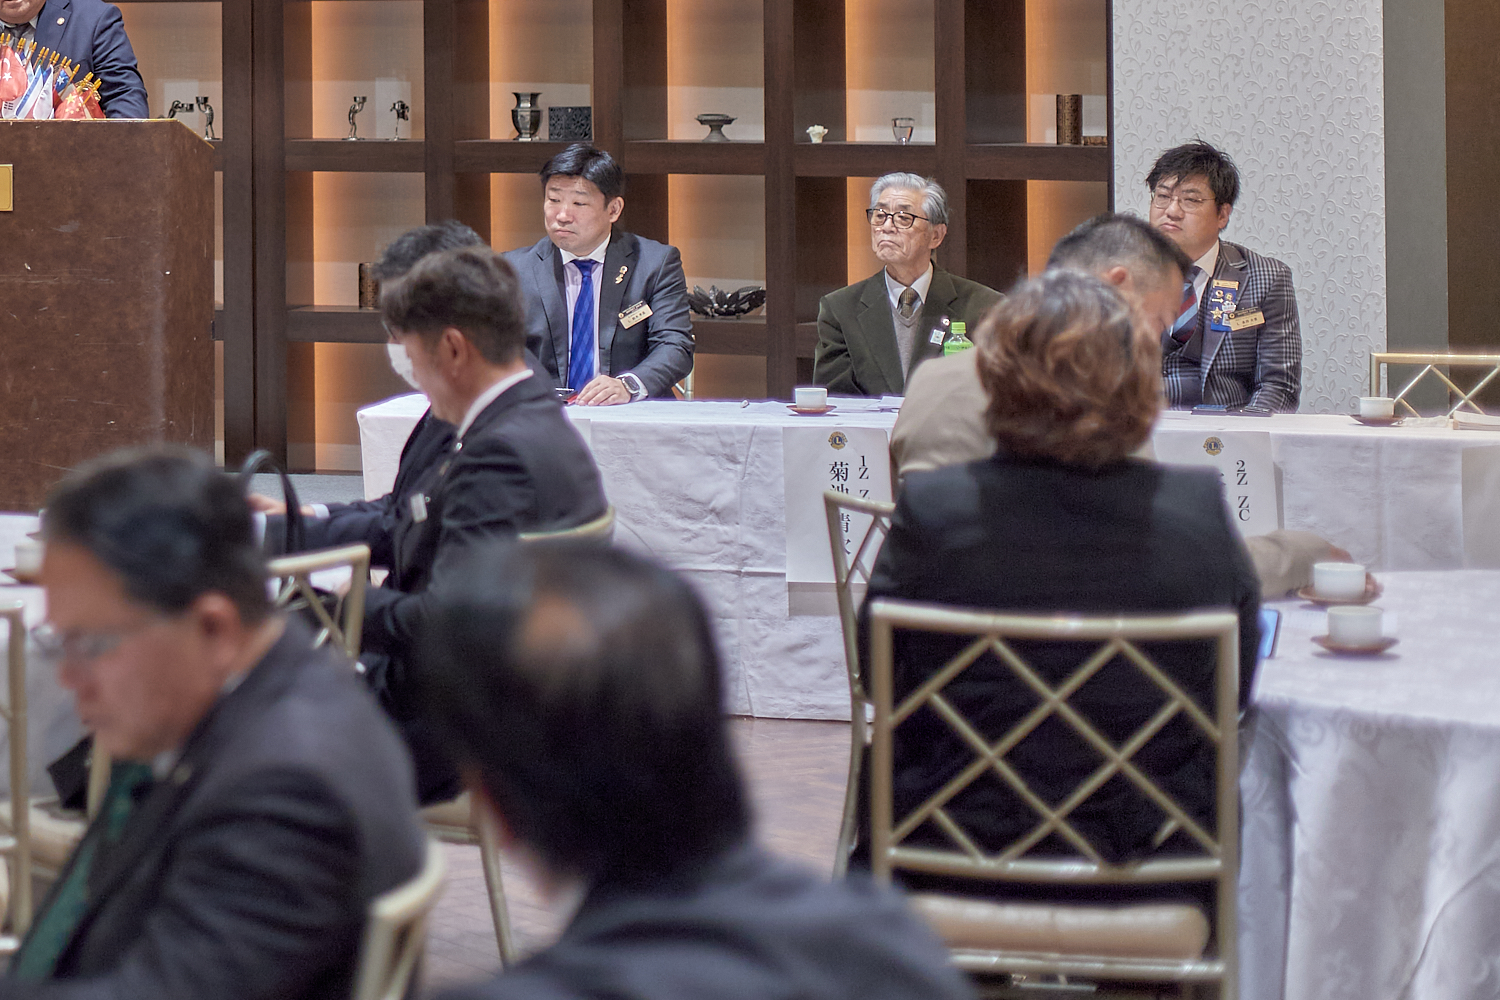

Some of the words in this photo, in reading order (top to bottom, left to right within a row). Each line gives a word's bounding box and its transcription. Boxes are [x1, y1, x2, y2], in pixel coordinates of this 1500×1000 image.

[858, 455, 870, 480] 1Z
[1236, 459, 1248, 486] 2Z
[1237, 495, 1251, 521] ZC
